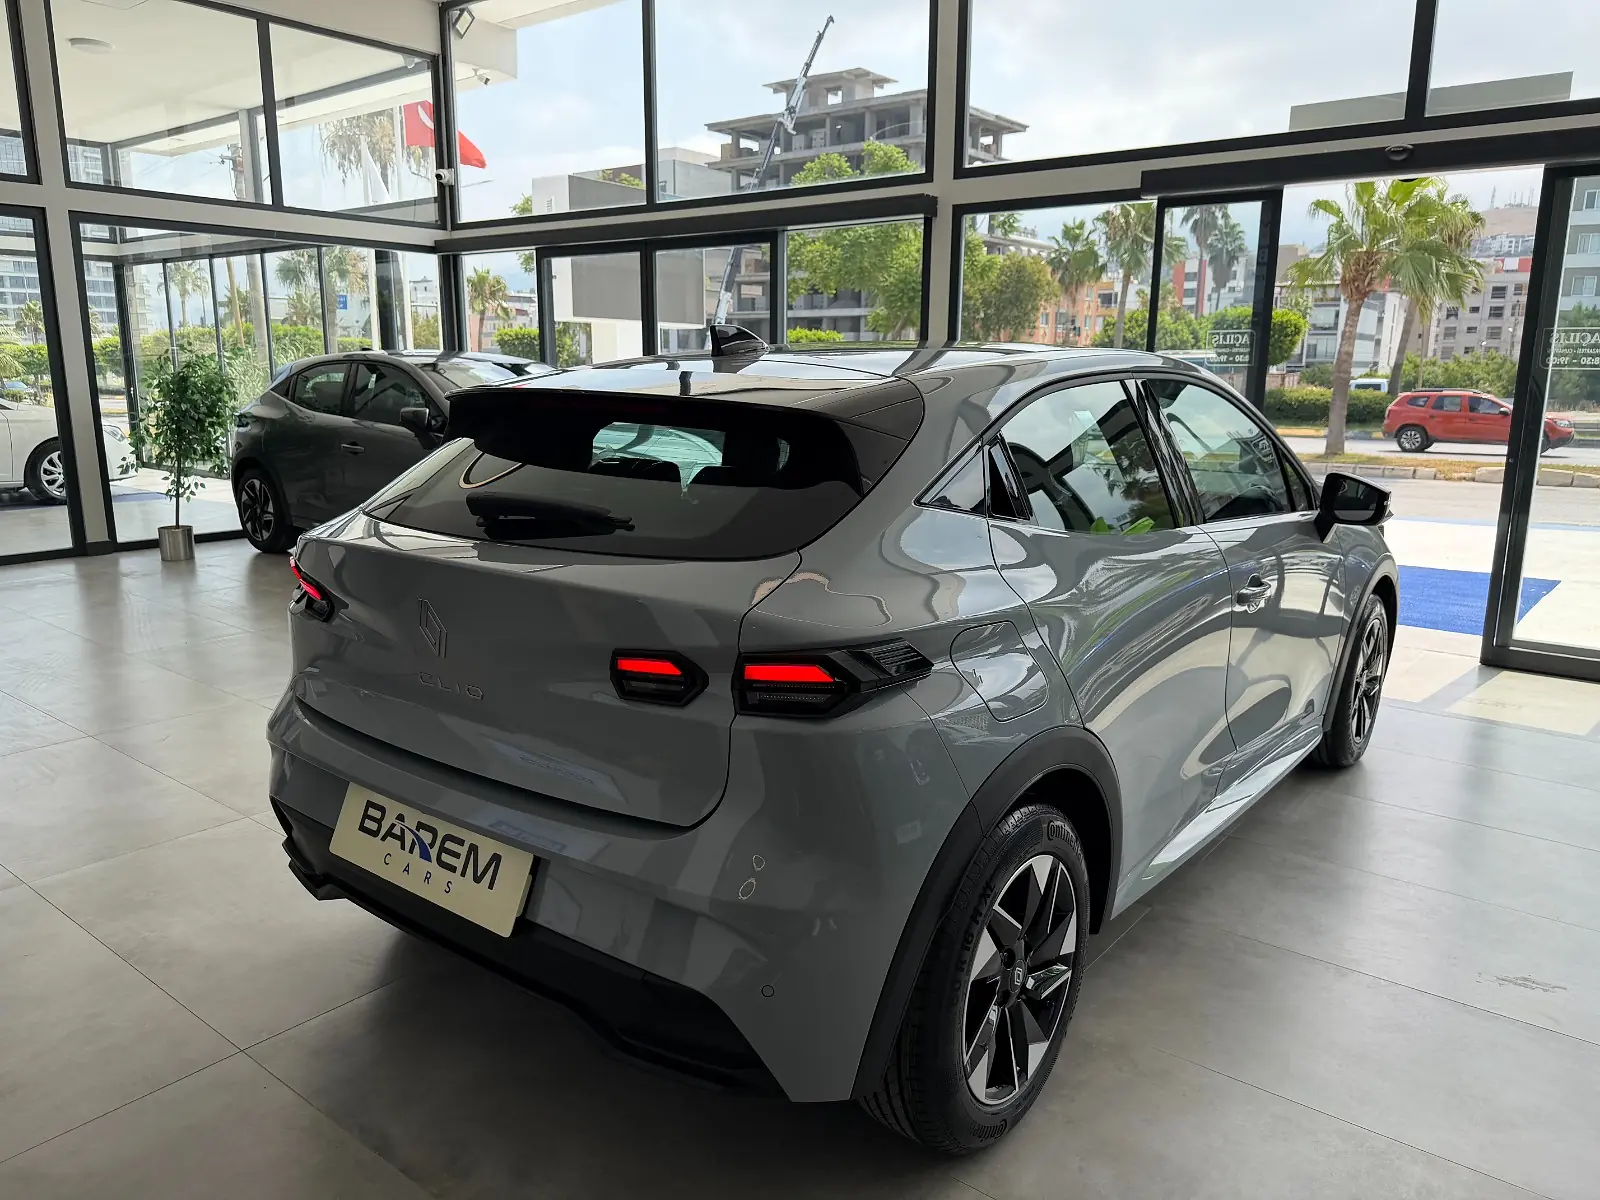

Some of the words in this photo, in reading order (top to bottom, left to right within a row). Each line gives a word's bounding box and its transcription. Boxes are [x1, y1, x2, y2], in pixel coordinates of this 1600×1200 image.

[420, 671, 484, 700] CLIO
[358, 799, 502, 891] BAREM
[383, 852, 453, 894] CARS
